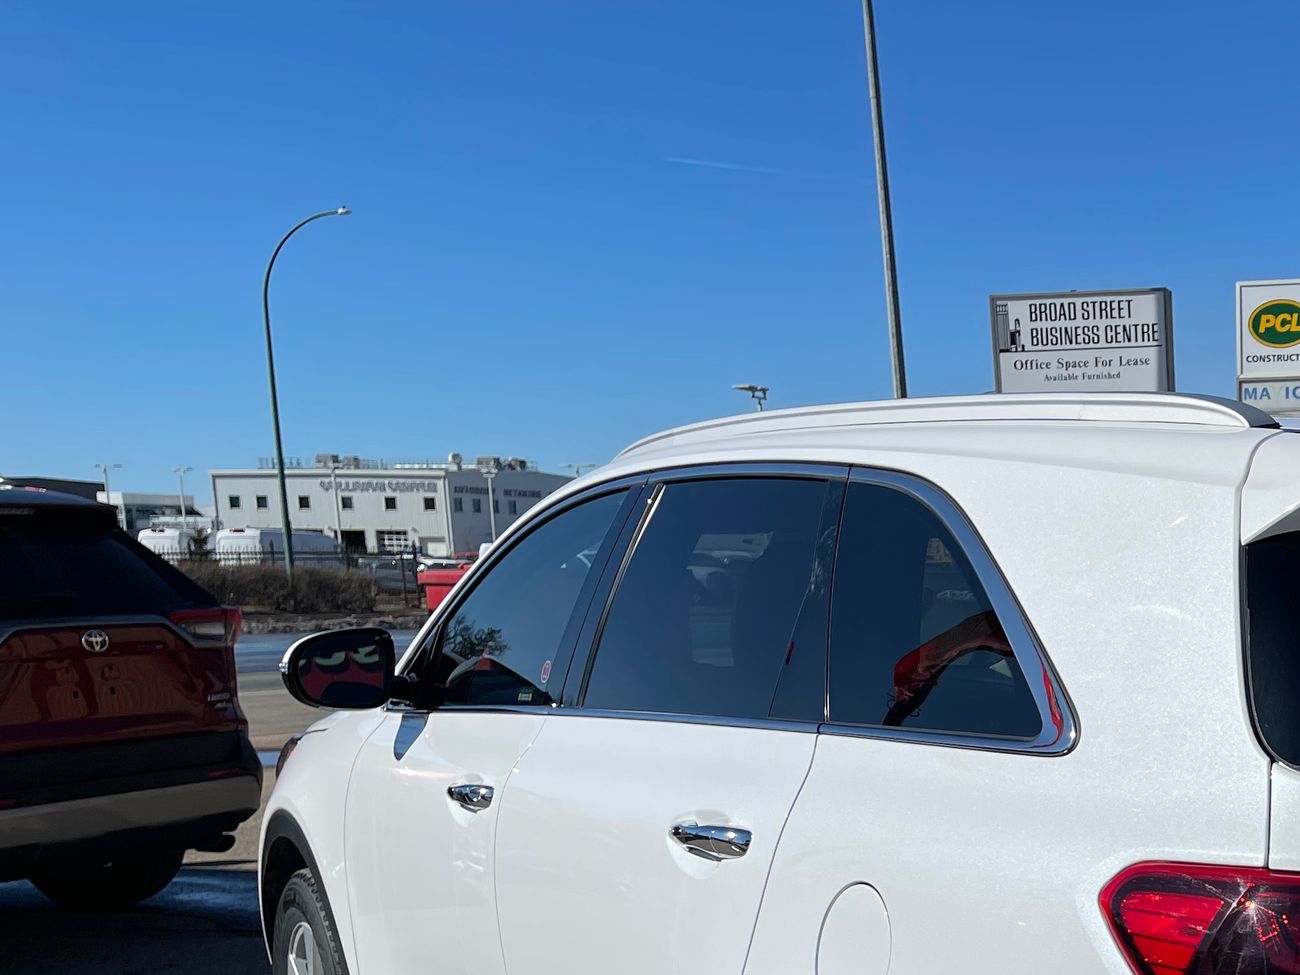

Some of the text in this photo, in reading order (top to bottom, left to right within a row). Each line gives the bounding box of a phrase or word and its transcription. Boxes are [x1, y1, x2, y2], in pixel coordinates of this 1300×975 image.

[1029, 299, 1133, 322] BROAD STREET
[1030, 323, 1159, 347] BUSINESS CENTRE
[1013, 355, 1151, 371] Office Space For Lease
[1043, 371, 1121, 382] Available Furnished
